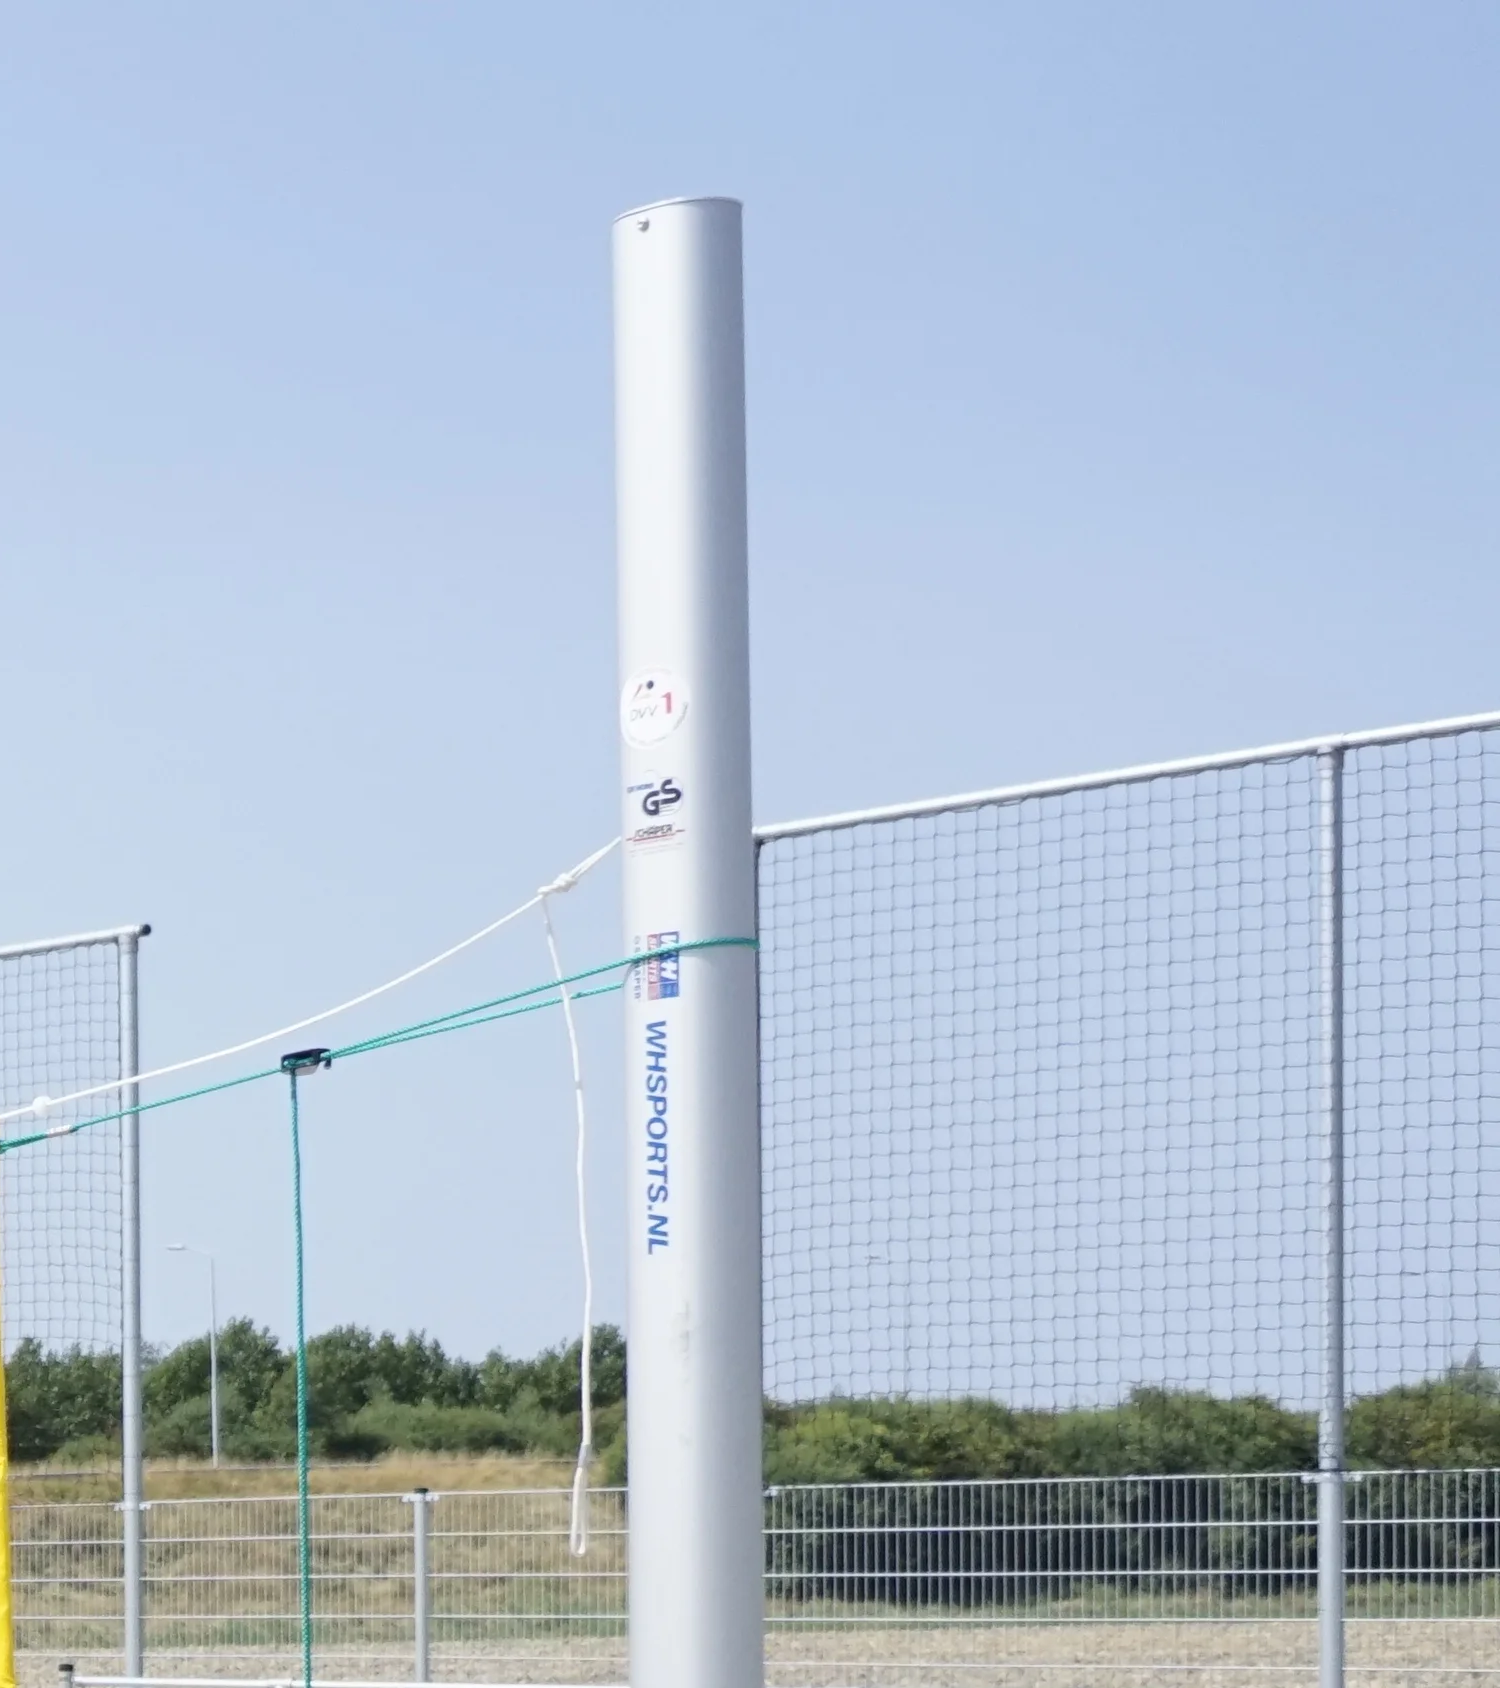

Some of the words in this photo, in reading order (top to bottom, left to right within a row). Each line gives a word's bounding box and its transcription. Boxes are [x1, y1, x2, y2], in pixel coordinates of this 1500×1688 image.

[630, 704, 658, 722] DVV
[660, 692, 672, 714] 1
[642, 778, 682, 816] GS
[646, 1020, 669, 1255] WHSPORTS.NL
